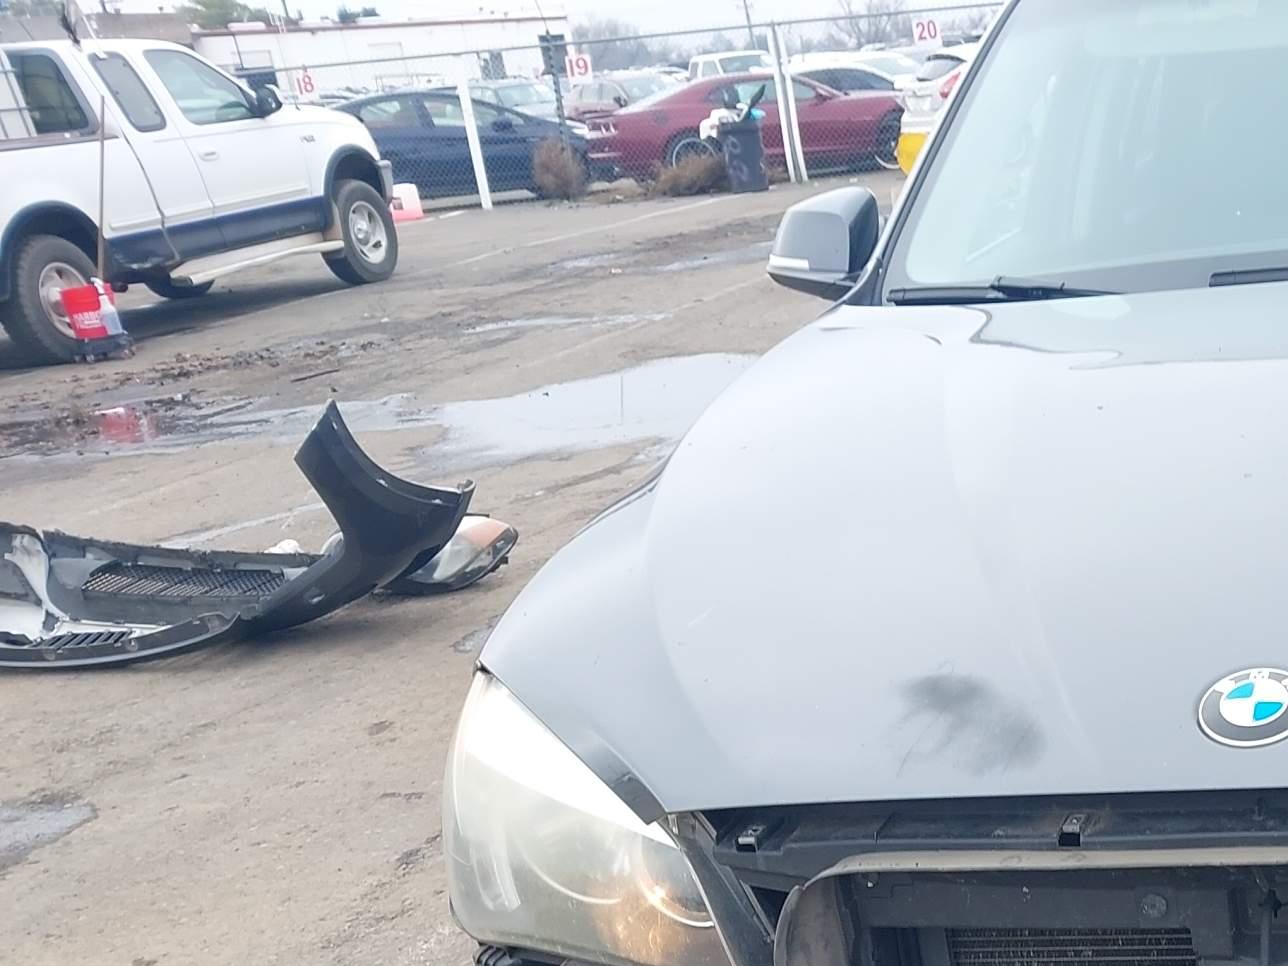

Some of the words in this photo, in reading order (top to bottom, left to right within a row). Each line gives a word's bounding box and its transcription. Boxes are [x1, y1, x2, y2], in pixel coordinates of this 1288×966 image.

[915, 19, 937, 41] 20
[568, 56, 588, 77] 19
[296, 74, 314, 95] 18
